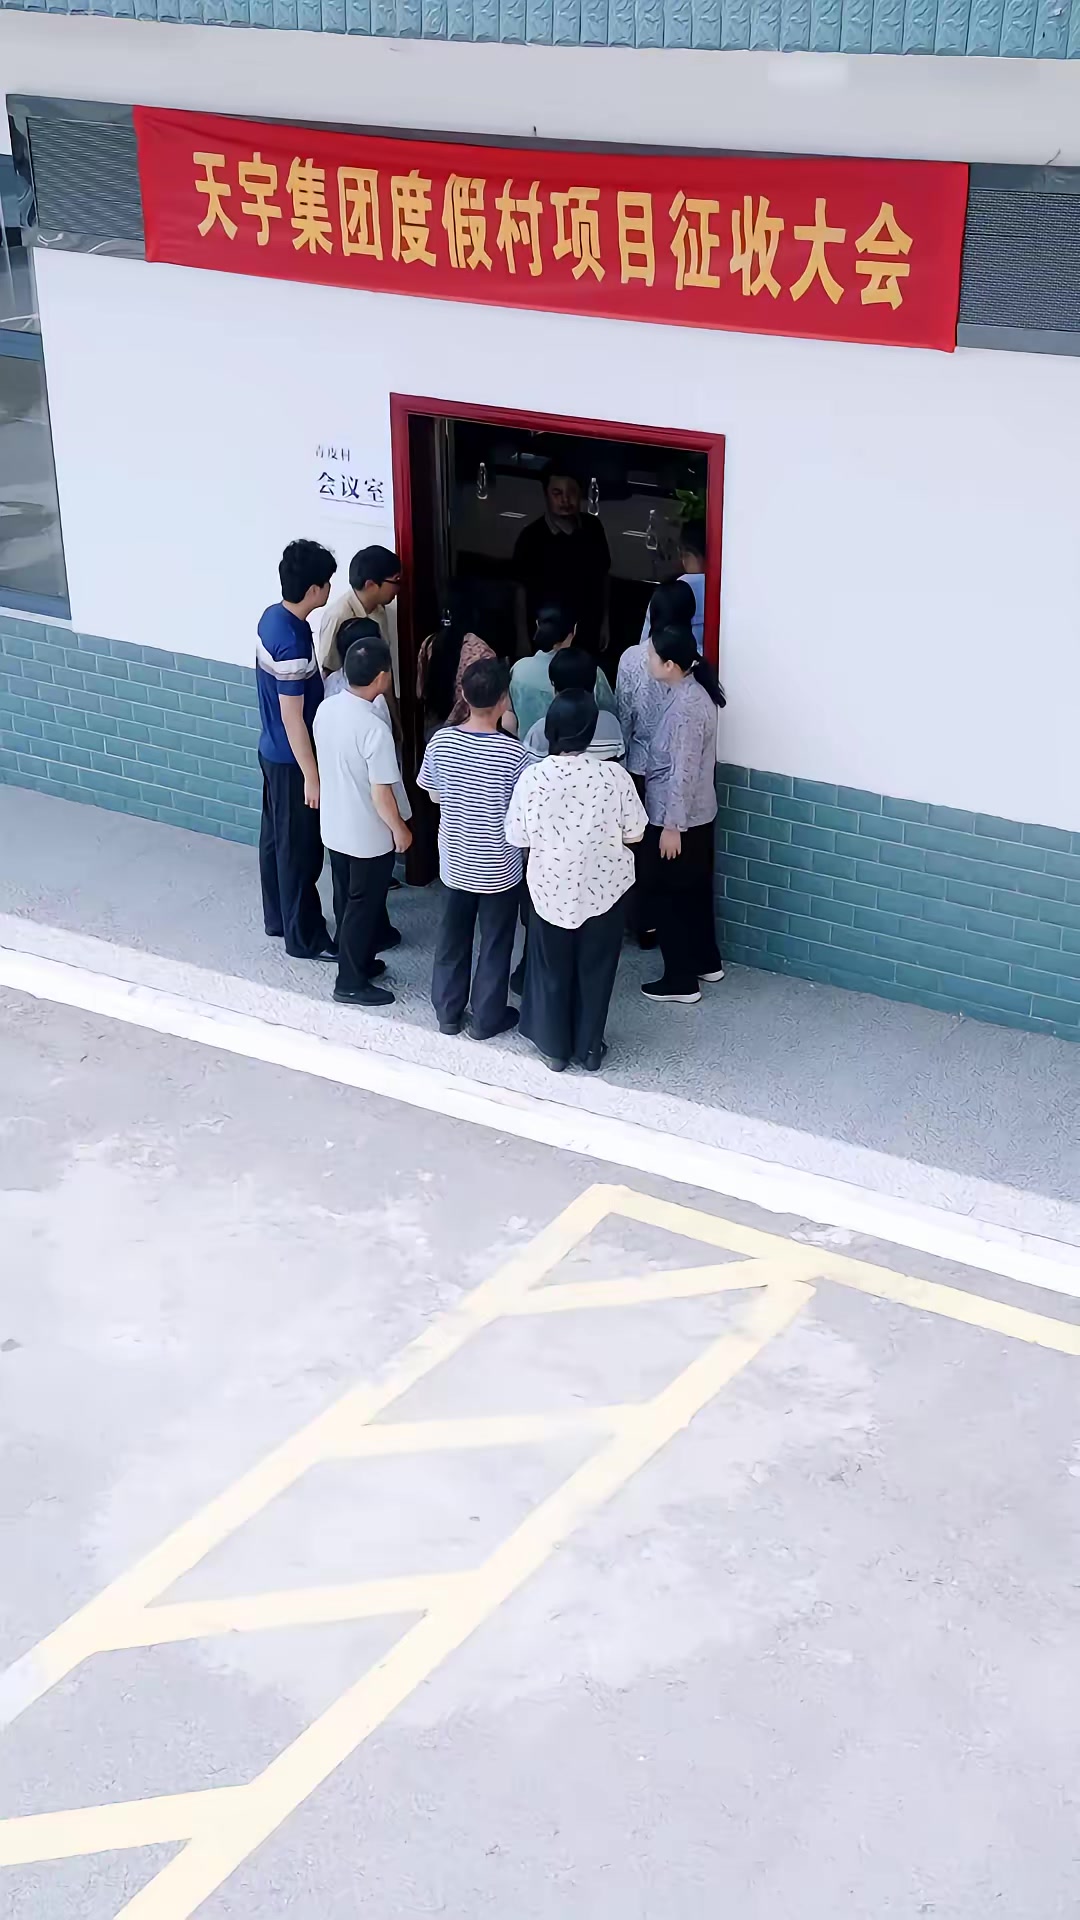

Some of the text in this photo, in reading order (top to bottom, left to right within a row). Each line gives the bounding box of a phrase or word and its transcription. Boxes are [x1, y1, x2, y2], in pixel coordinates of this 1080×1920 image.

[193, 151, 913, 310] 天宇集团度假村项目征收大会
[317, 471, 385, 503] 会议室
